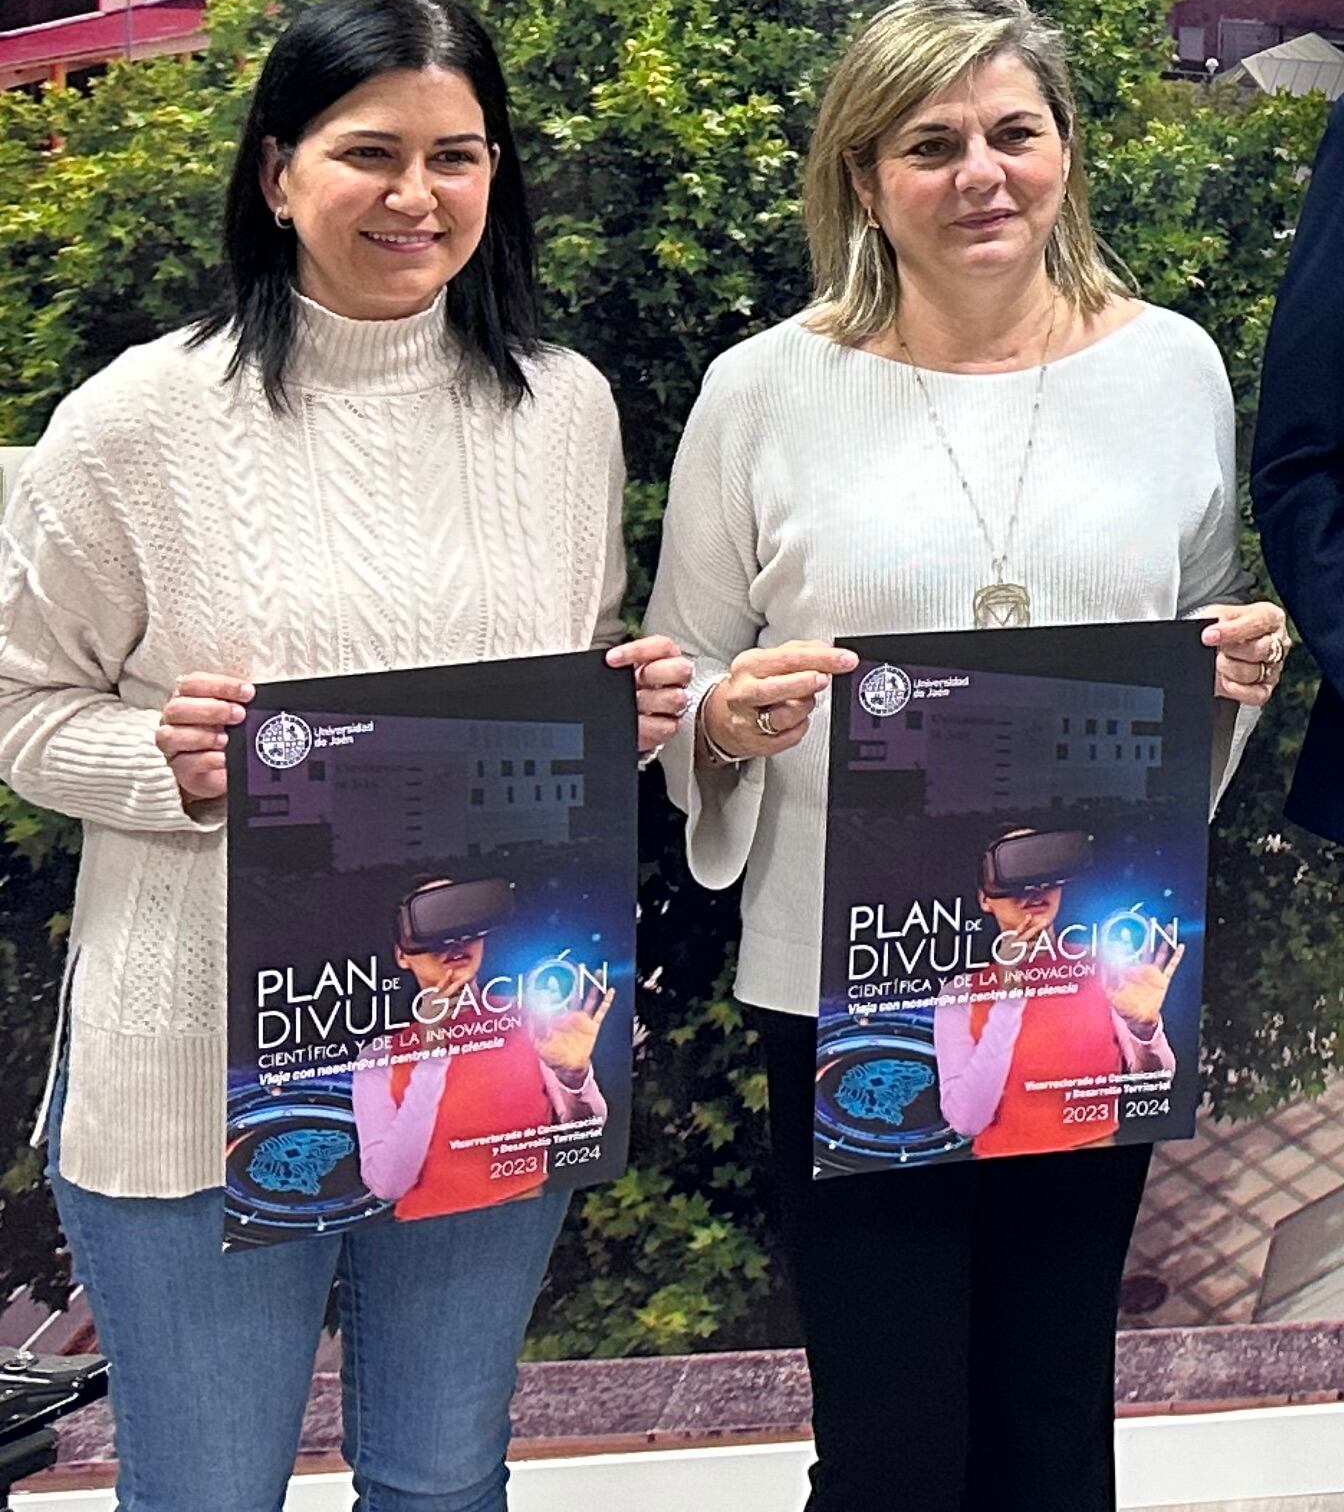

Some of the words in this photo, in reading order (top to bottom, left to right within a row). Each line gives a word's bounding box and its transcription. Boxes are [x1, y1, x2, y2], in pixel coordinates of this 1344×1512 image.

[848, 903, 1178, 980] DIVULGACIÓN
[850, 897, 962, 940] PLAN
[965, 918, 982, 931] DE
[258, 950, 608, 1049] DIVULGACIÓN
[259, 956, 377, 1007] PLAN
[382, 978, 399, 990] DE
[848, 978, 932, 998] CIENTÍFICA
[938, 978, 948, 990] Y
[954, 975, 973, 988] DE
[980, 973, 998, 986] LA
[1005, 962, 1095, 984] INNOVACIÓN
[259, 1043, 347, 1069] CIENTÍFICA
[354, 1041, 364, 1054] Y
[372, 1037, 391, 1051] DE
[399, 1033, 418, 1047] LA
[425, 1015, 521, 1043] INNOVACIÓN
[1063, 1104, 1108, 1124] 2023
[1126, 1098, 1170, 1117] 2024
[490, 1157, 537, 1179] 2023
[554, 1145, 601, 1167] 2024
